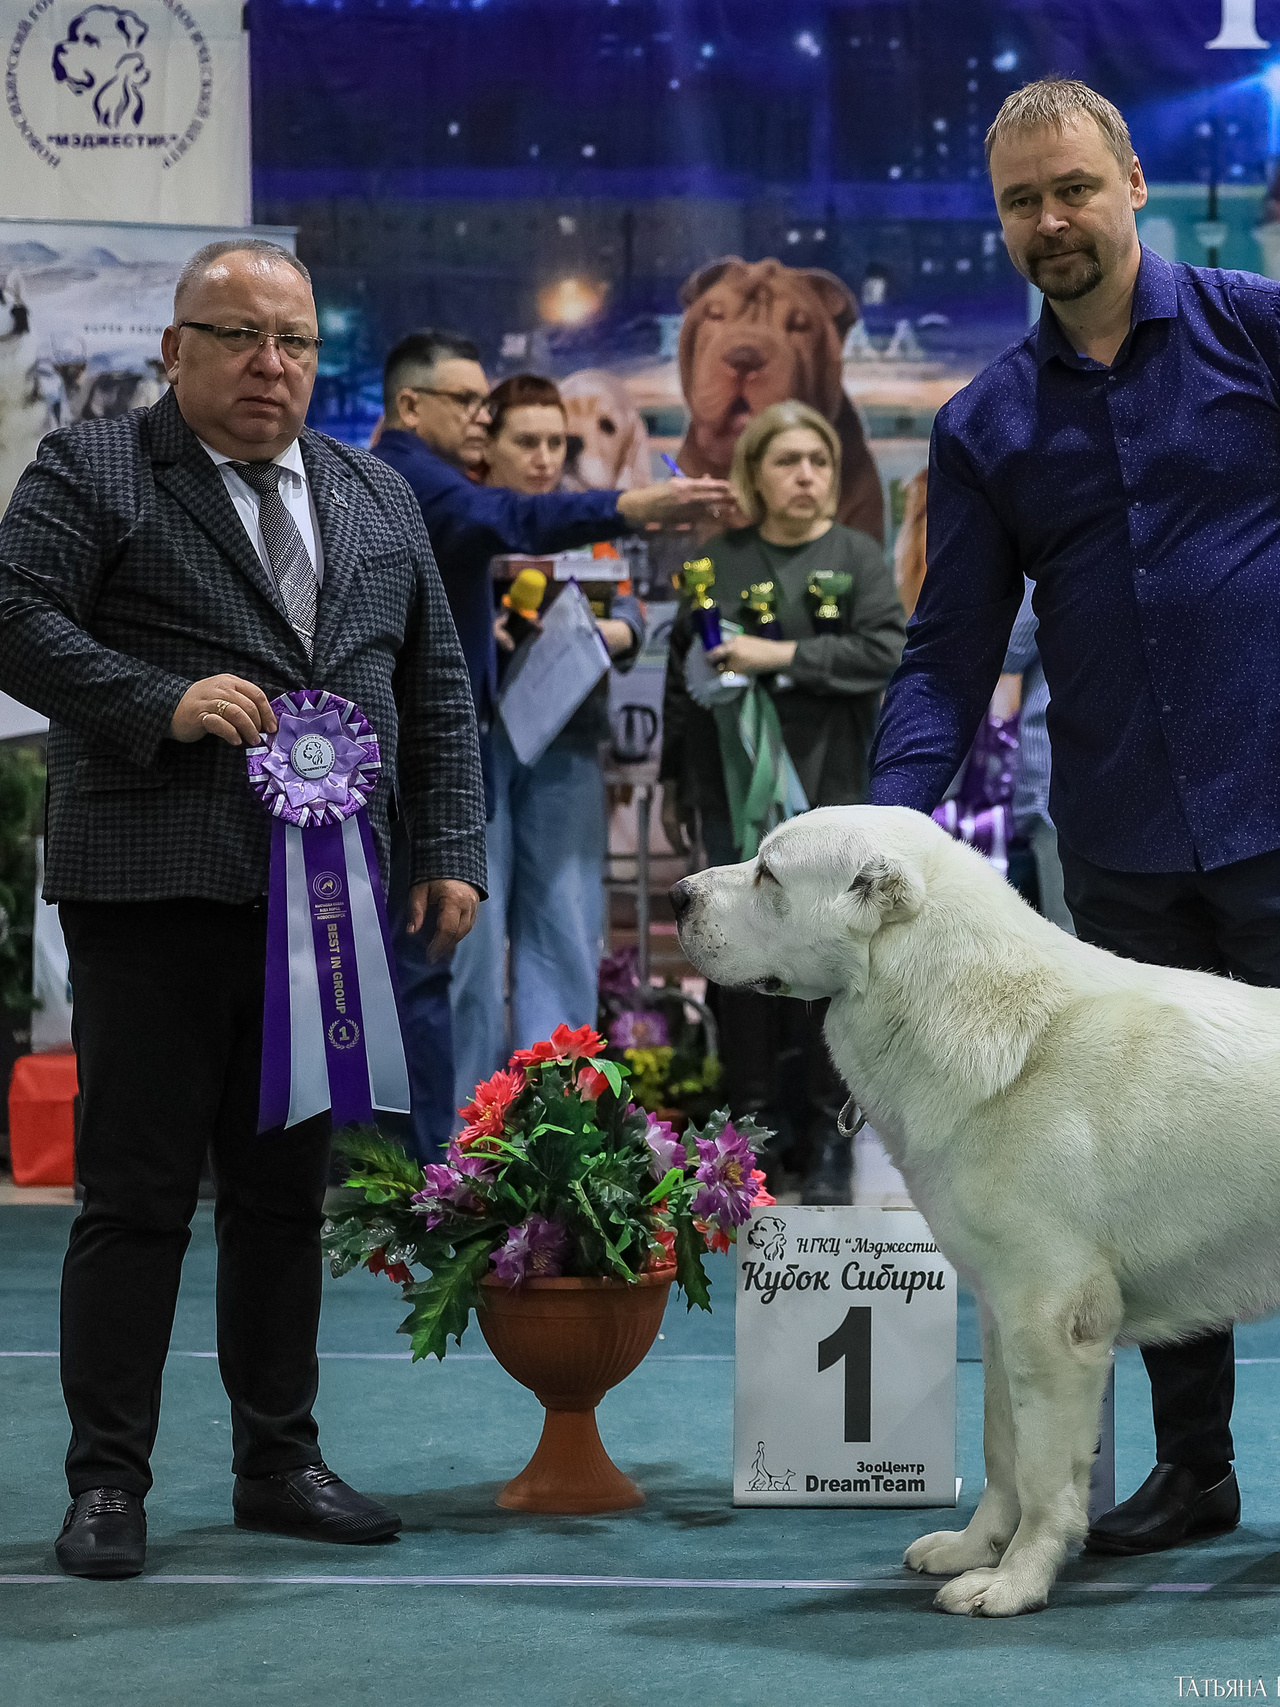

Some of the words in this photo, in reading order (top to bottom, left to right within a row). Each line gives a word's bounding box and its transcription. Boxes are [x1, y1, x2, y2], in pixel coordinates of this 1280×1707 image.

[327, 923, 340, 953] BEST
[330, 956, 342, 969] IN
[332, 971, 346, 1015] GROUP
[338, 1026, 350, 1041] 1
[796, 1237, 841, 1257] НГКЦ
[741, 1261, 831, 1305] Кубок
[841, 1261, 946, 1305] Сибири
[818, 1306, 872, 1443] 1
[856, 1461, 925, 1475] ЗооЦентр
[805, 1475, 926, 1493] DreamTeam
